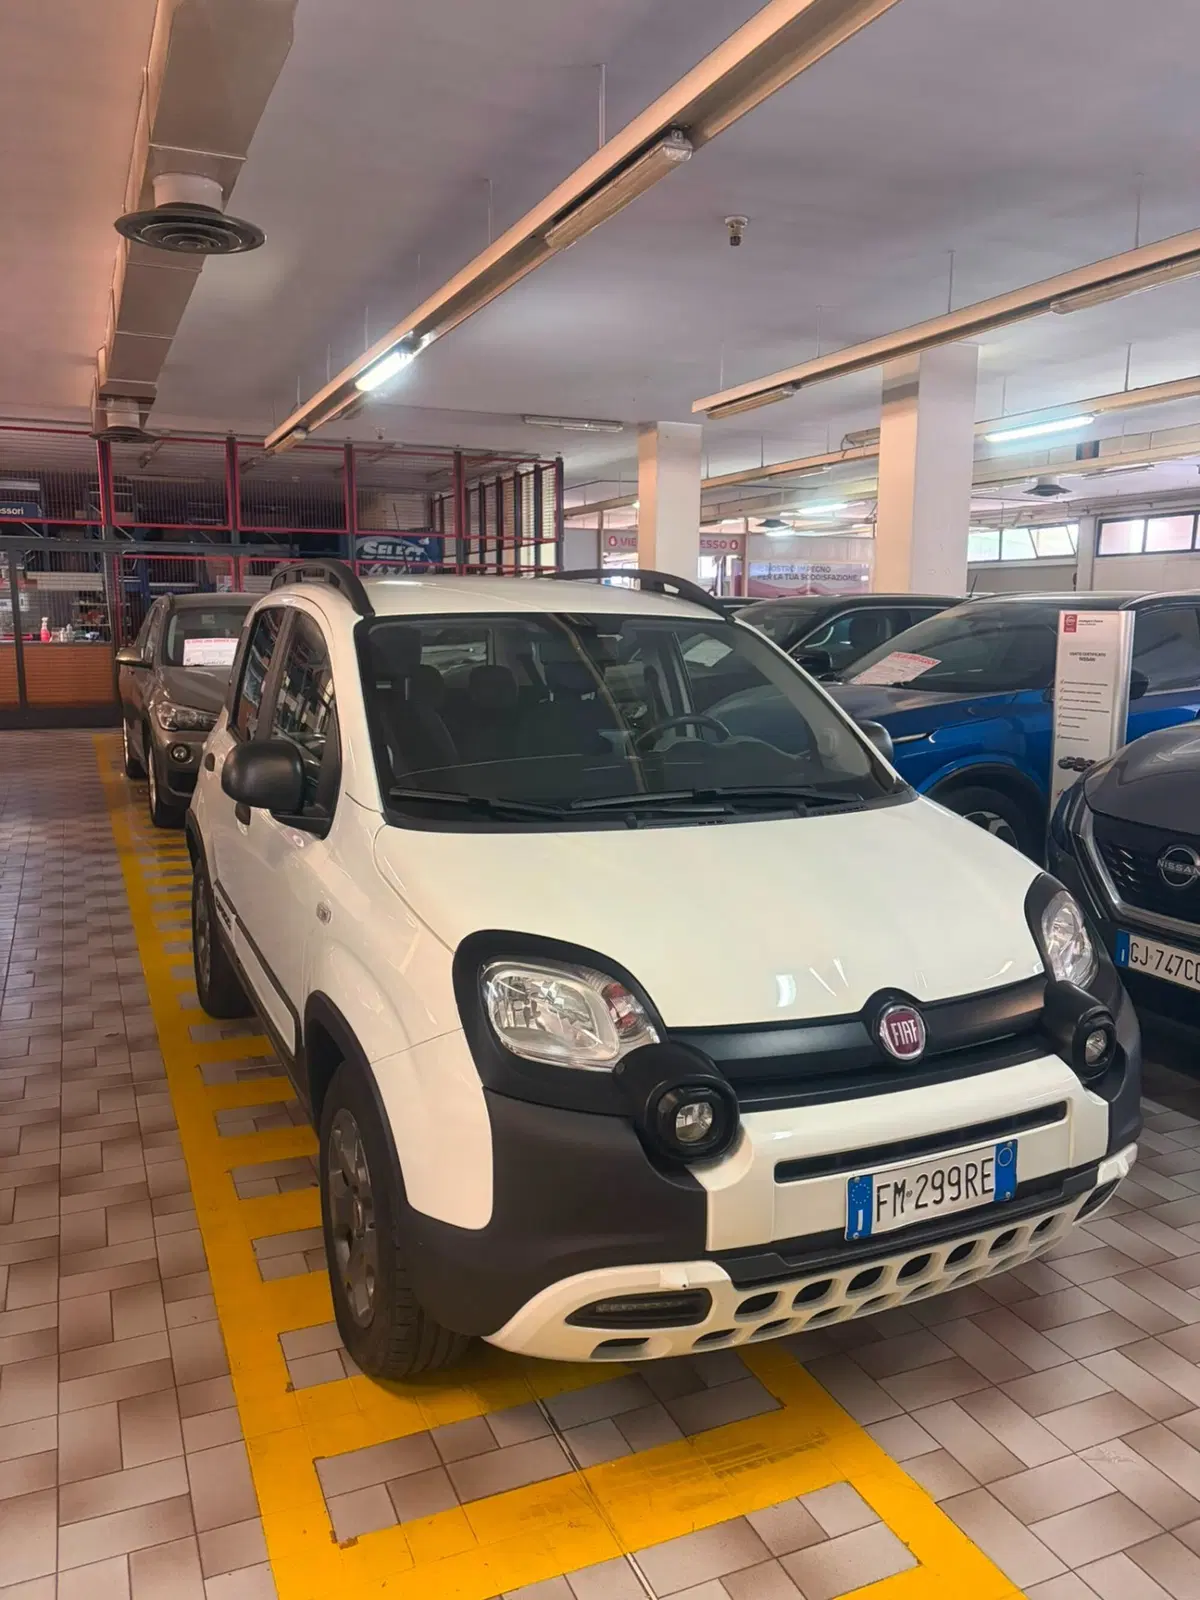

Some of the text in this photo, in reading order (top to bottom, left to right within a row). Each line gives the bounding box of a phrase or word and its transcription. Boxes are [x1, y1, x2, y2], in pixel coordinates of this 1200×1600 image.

[0, 507, 24, 515] ssori
[1156, 858, 1200, 876] NISSAN
[890, 1019, 917, 1046] FIAT
